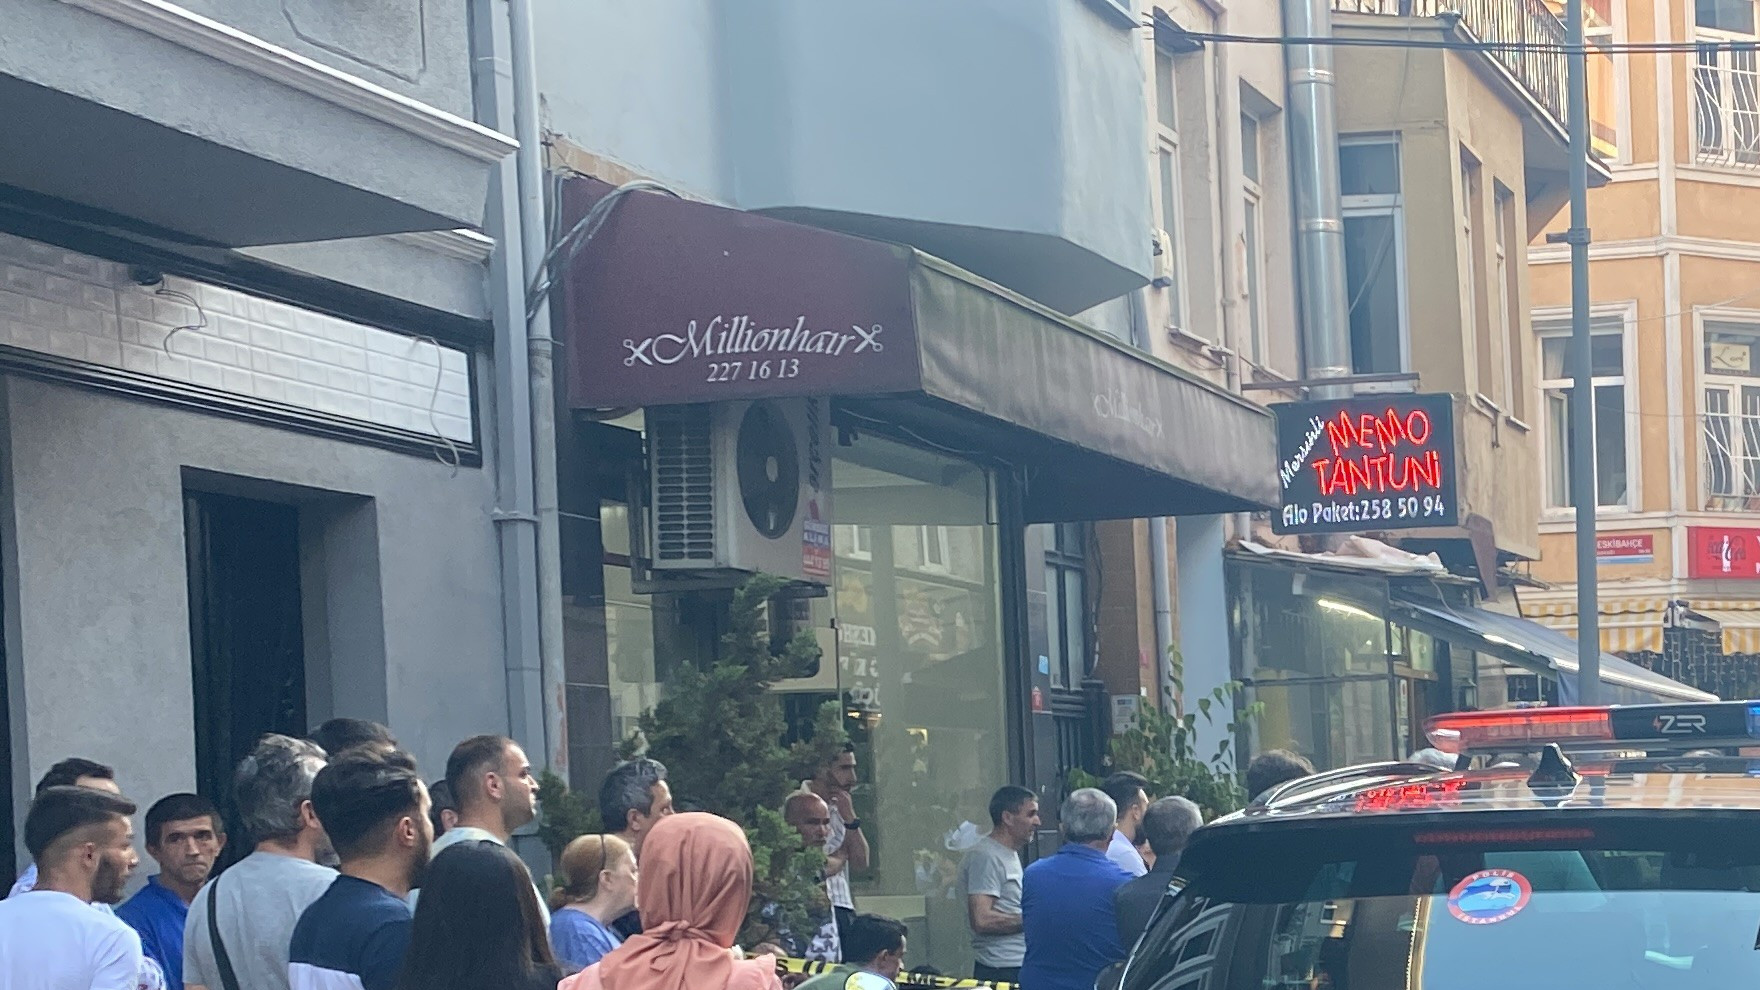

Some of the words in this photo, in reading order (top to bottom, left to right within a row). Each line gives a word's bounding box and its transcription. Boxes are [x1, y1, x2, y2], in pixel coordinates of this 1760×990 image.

[652, 315, 856, 364] Millionhair
[706, 362, 741, 382] 227
[748, 361, 771, 380] 16
[777, 358, 799, 378] 13
[1325, 407, 1432, 457] MEMO
[1283, 504, 1308, 527] Alo
[1398, 497, 1418, 518] 50
[1423, 494, 1445, 516] 94
